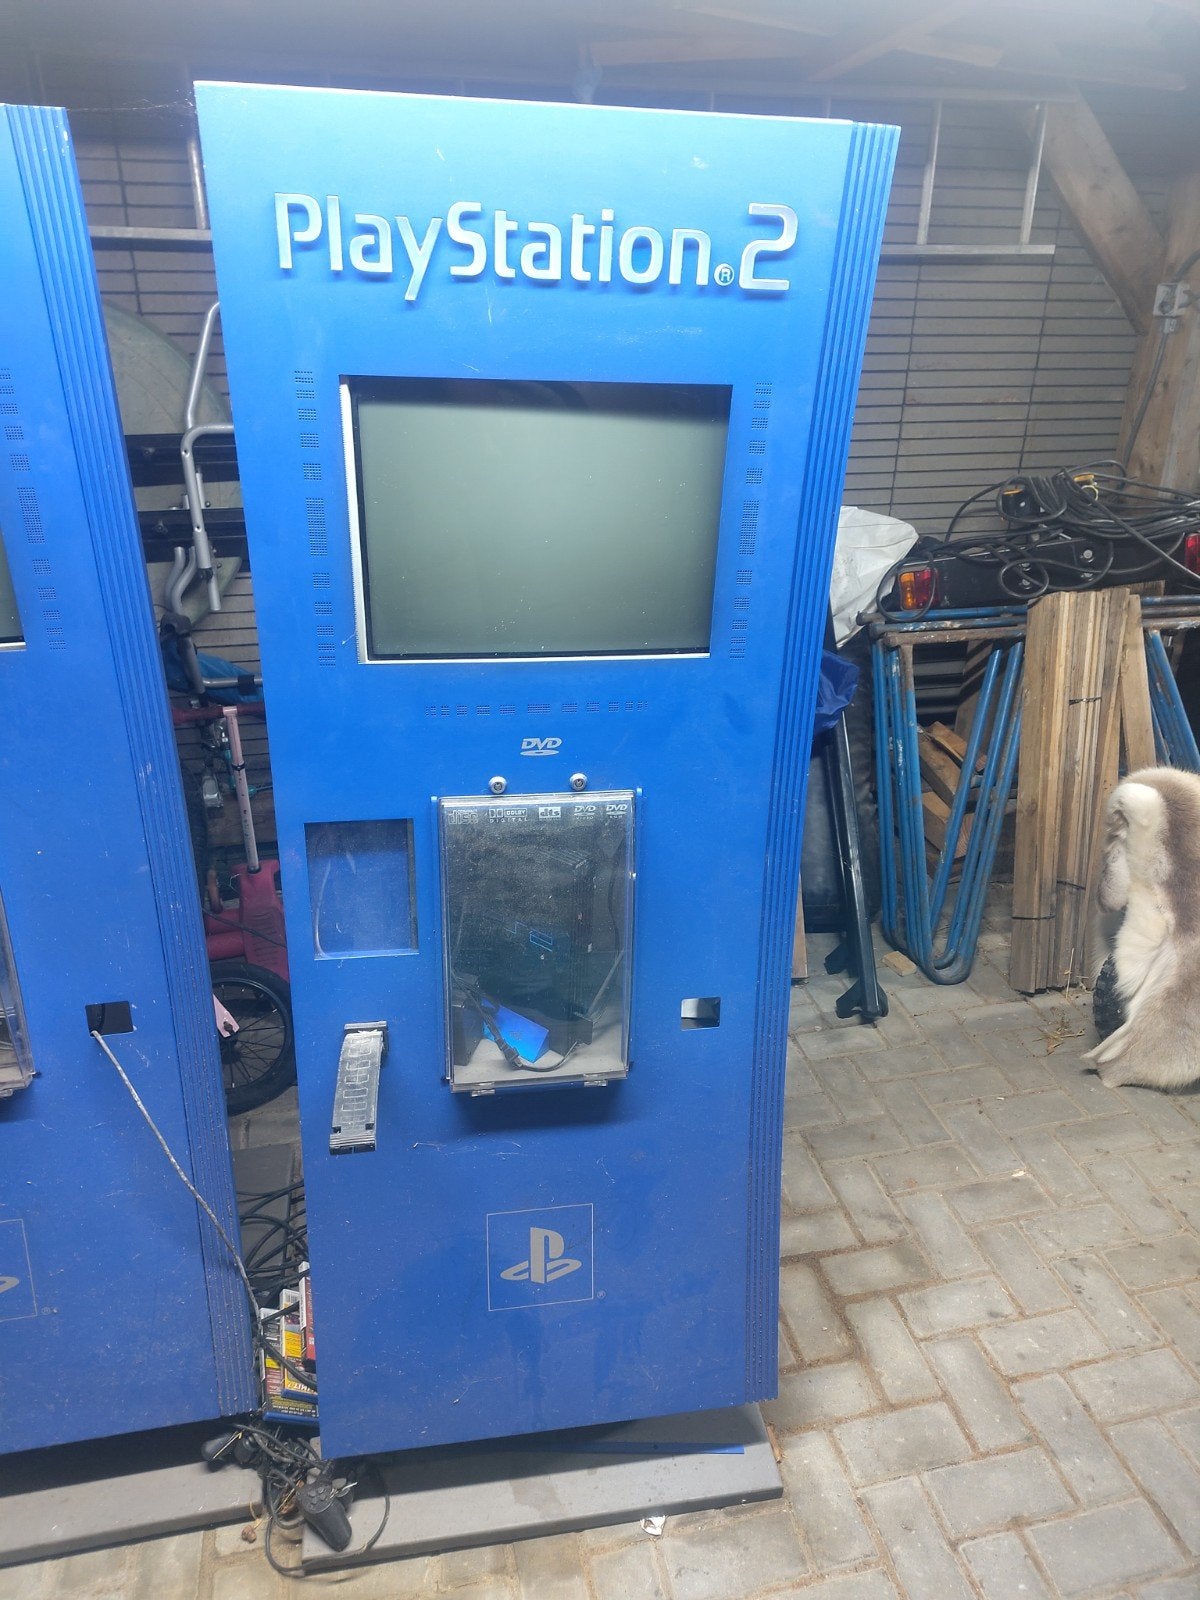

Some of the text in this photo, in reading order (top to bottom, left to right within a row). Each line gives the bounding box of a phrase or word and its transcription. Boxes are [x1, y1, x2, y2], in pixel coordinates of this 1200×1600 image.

[275, 192, 798, 300] PlayStation 2
[521, 737, 562, 749] DVD
[574, 805, 596, 813] DVD
